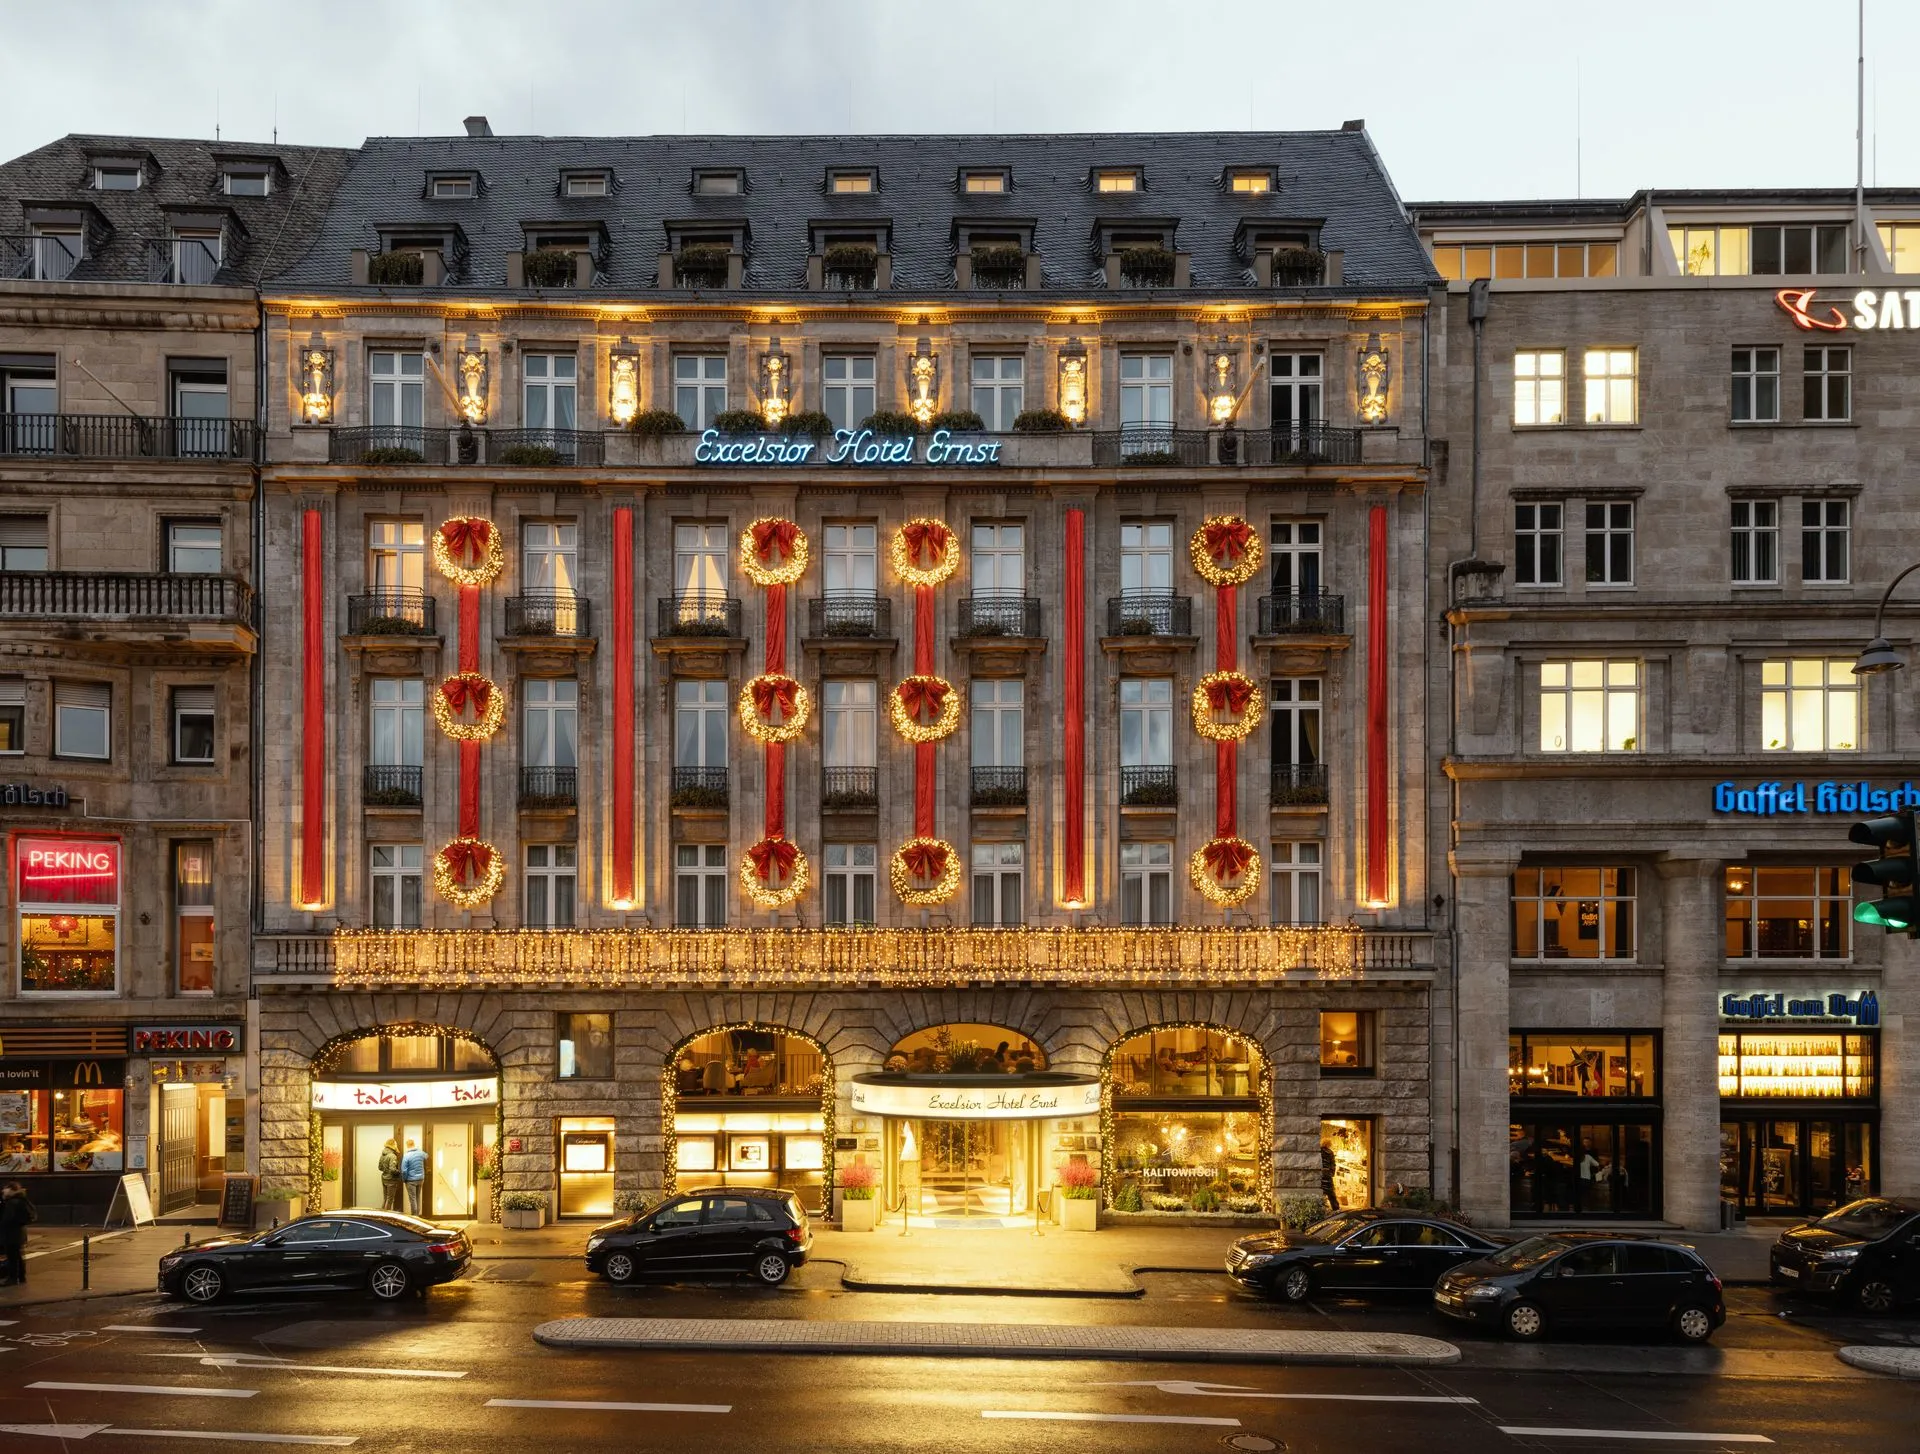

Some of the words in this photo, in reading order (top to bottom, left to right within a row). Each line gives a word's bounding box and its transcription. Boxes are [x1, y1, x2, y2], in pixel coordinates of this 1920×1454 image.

[1854, 291, 1920, 329] SAT
[695, 429, 816, 462] Excelsior
[827, 429, 914, 462] Hotel
[926, 430, 1002, 462] Ernst
[0, 784, 67, 806] ölsch
[1714, 781, 1809, 815] Gaffel
[30, 850, 110, 870] PEKING
[1722, 993, 1786, 1018] Gaffel
[135, 1030, 235, 1049] PEKING
[354, 1088, 407, 1105] taku
[451, 1085, 491, 1102] taku
[928, 1094, 982, 1109] Excelsior
[987, 1093, 1027, 1109] Hotel
[1029, 1095, 1059, 1109] Ernst
[1143, 1167, 1218, 1177] KALITOWITSCH
